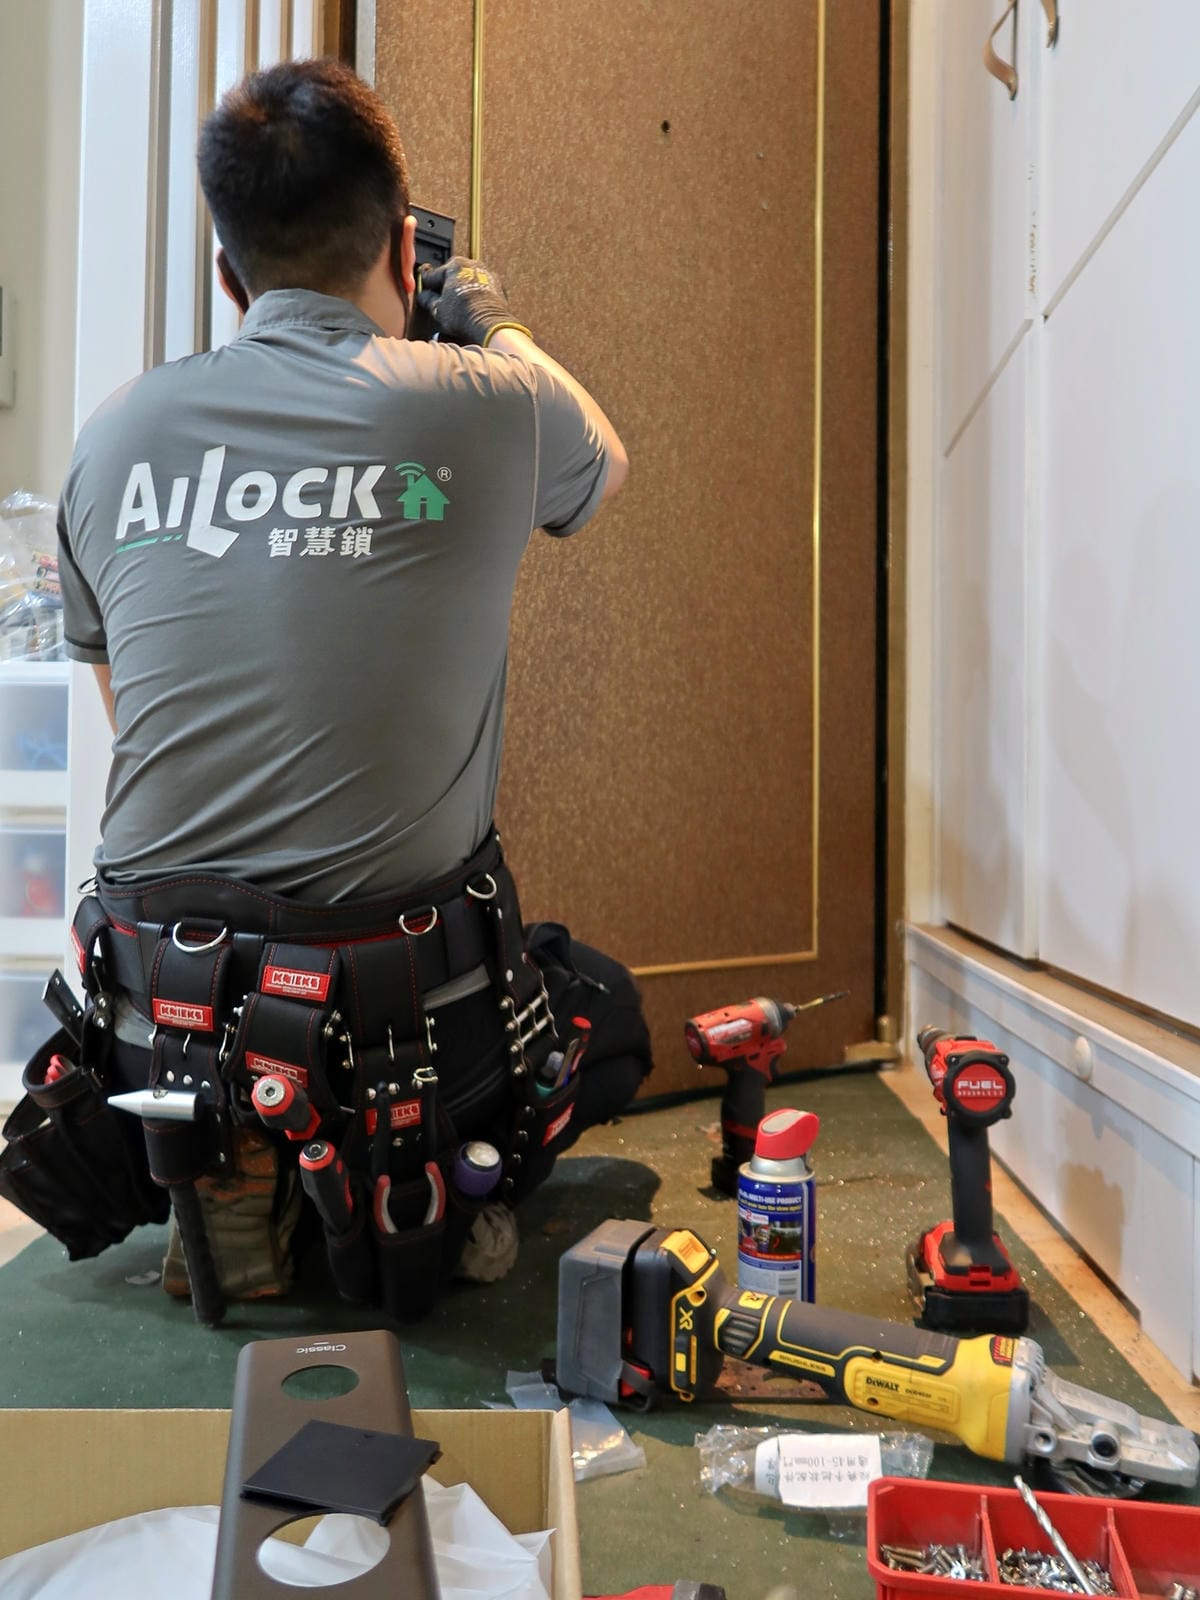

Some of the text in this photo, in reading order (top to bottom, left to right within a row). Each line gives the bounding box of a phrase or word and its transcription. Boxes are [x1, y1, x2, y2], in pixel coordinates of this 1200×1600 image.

[268, 527, 374, 558] 智慧鎖
[958, 1080, 1003, 1089] FUEL
[679, 1306, 694, 1331] XR
[296, 1344, 347, 1354] Classic
